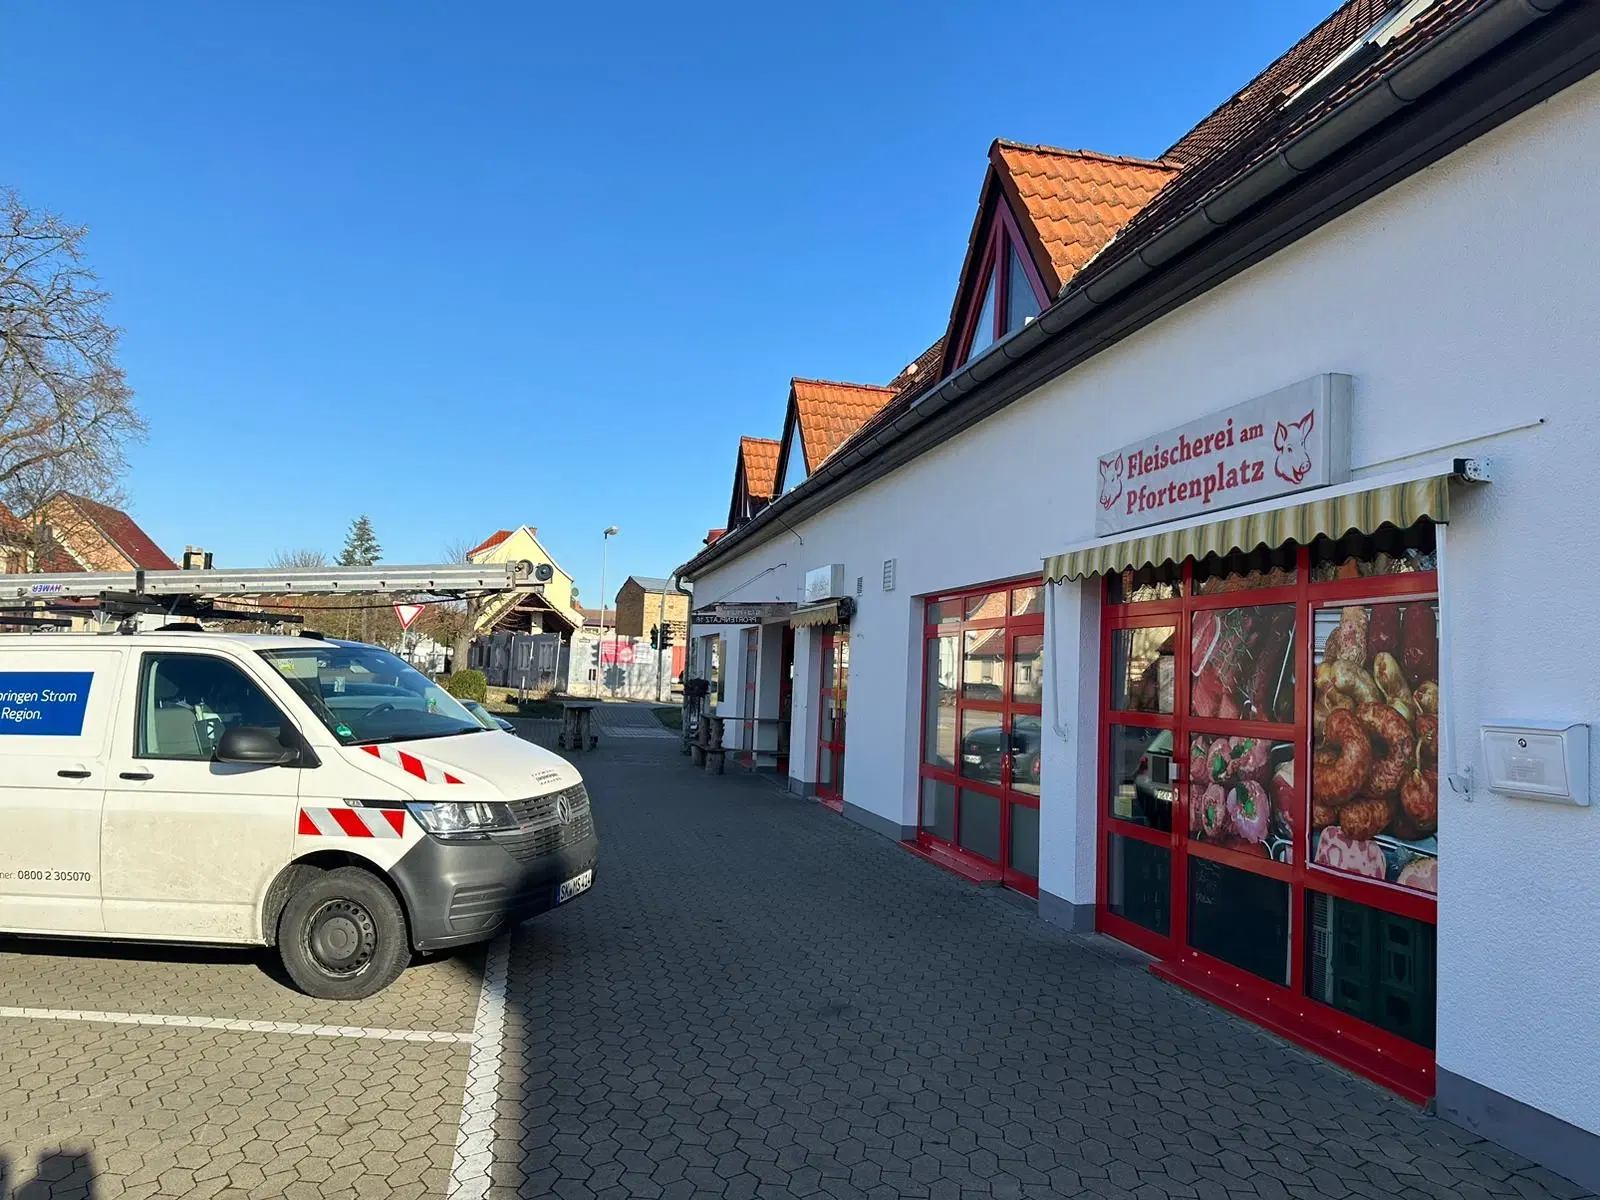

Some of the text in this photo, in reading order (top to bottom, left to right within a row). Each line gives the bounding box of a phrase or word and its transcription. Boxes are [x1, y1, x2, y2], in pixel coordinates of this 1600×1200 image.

[1127, 418, 1264, 480] Fleischerei am
[1126, 459, 1265, 515] Pfortenplatz
[41, 689, 78, 702] Strom
[1, 707, 43, 723] Region.
[17, 870, 43, 880] 0800
[45, 871, 52, 880] 2
[54, 871, 91, 882] 305070
